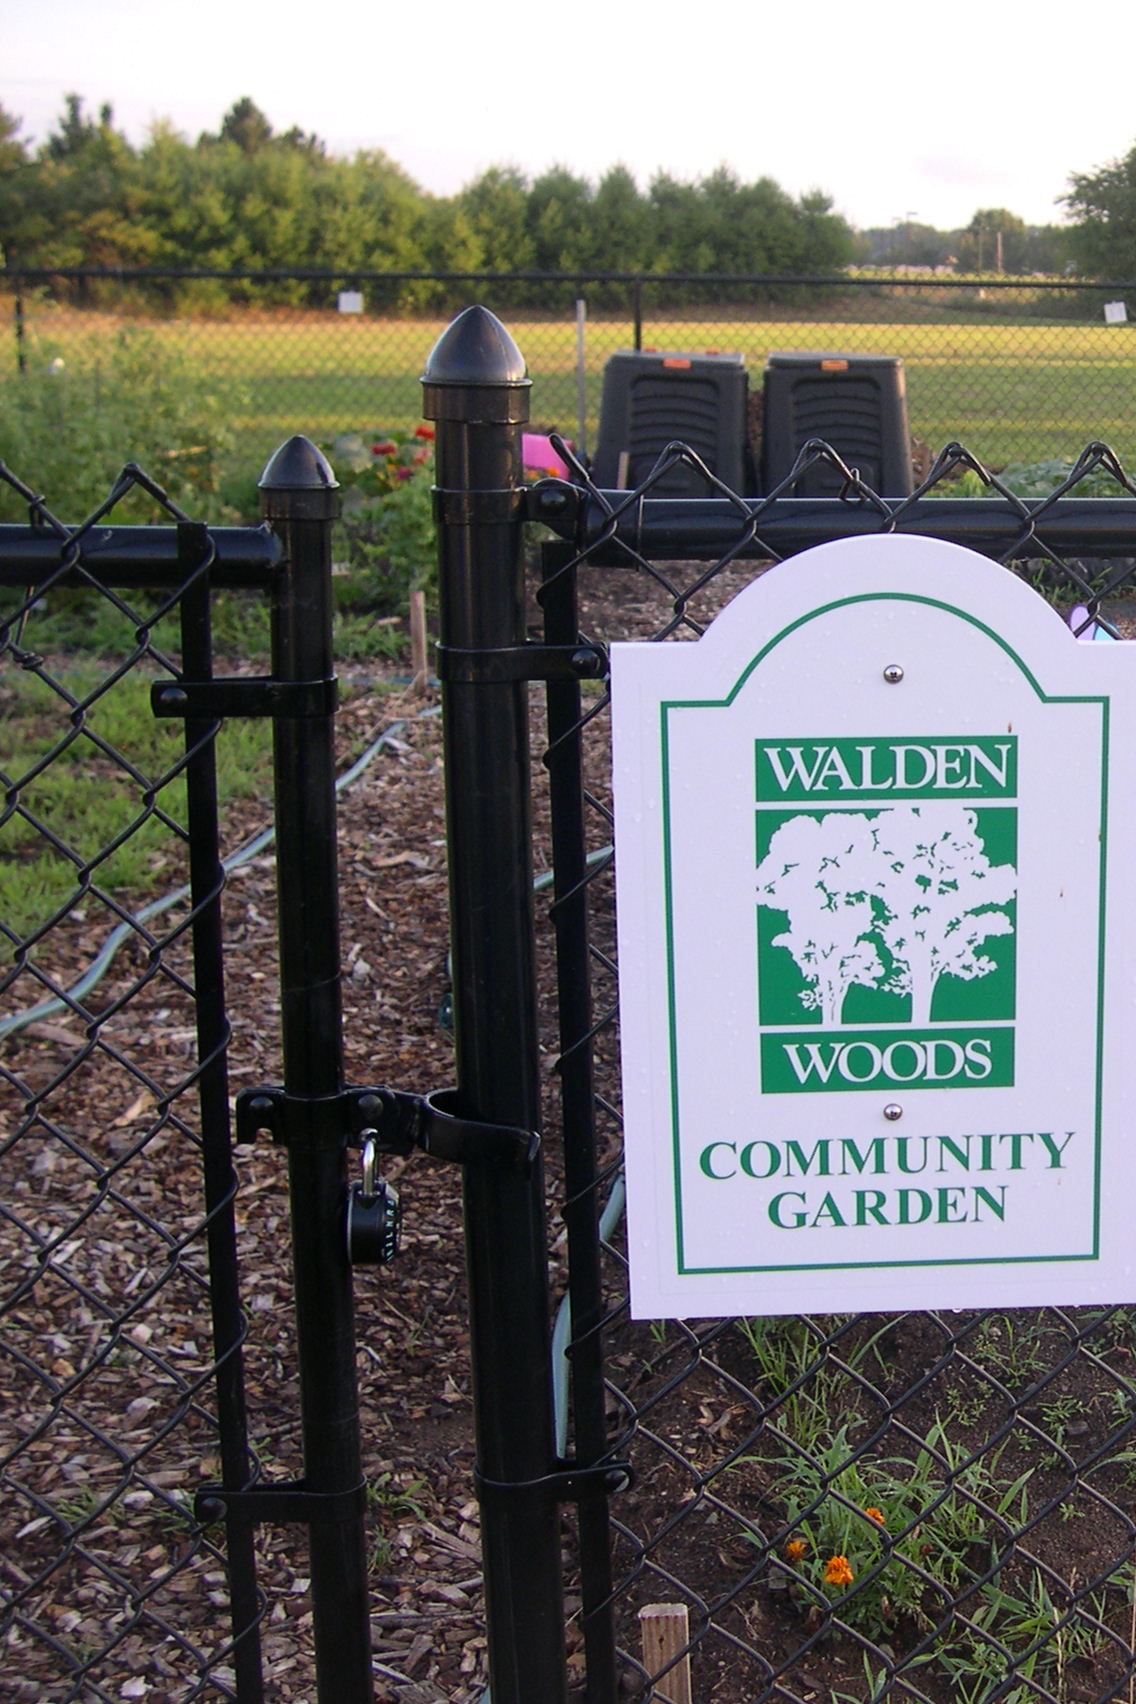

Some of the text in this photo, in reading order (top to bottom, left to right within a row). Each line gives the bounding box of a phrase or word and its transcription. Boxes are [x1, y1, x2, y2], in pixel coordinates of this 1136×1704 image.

[763, 744, 1012, 792] WALDEN
[782, 1038, 993, 1085] WOODS
[699, 1131, 1077, 1180] COMMUNITY
[767, 1184, 1009, 1229] GARDEN
